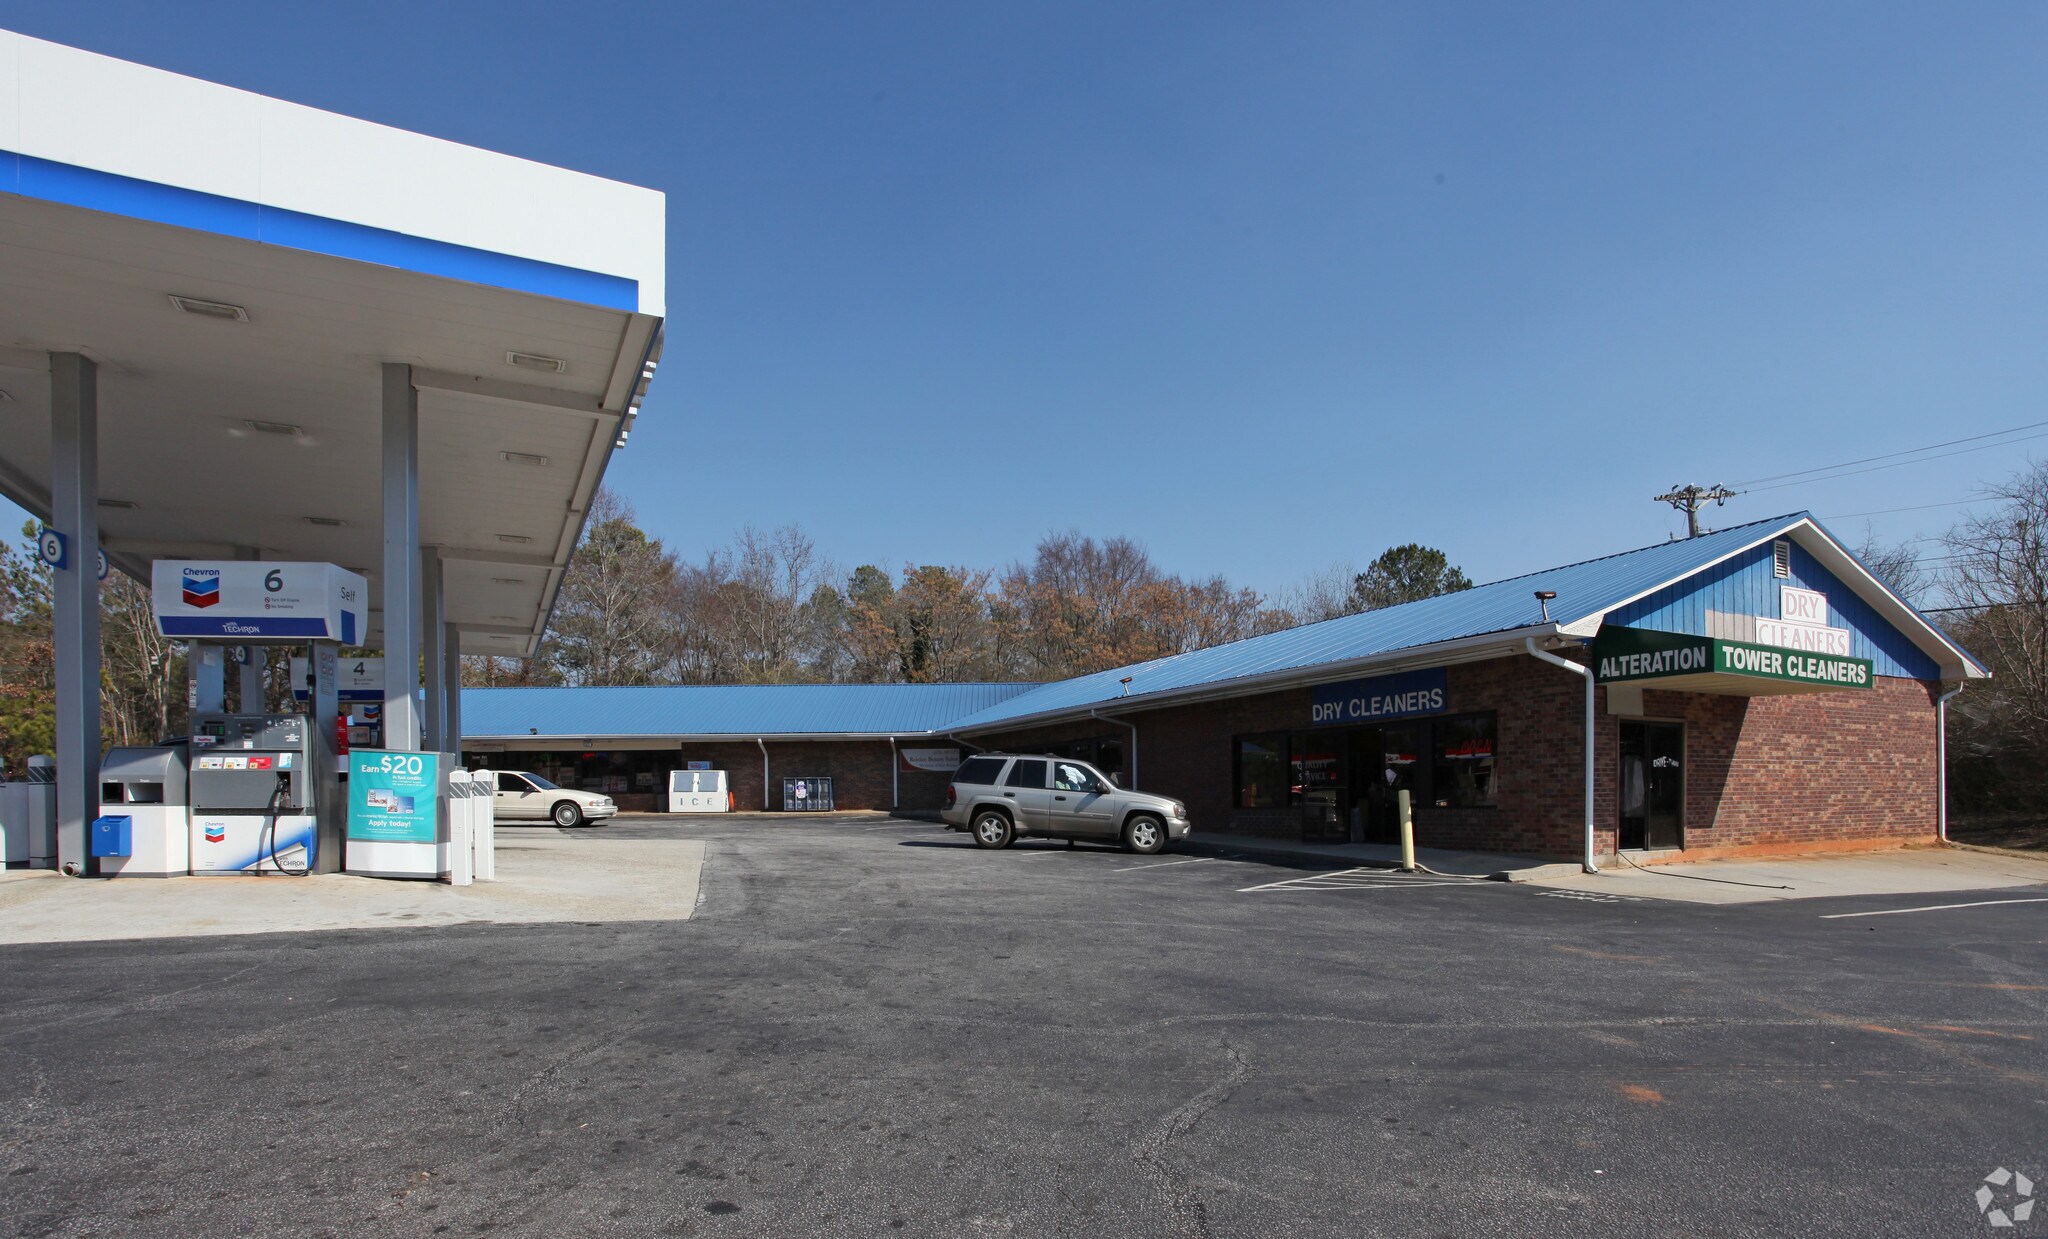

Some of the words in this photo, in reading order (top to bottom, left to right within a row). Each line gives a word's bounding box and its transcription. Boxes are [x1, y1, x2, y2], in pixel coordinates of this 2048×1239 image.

[47, 540, 57, 556] 6
[183, 567, 220, 576] Chevron
[264, 568, 283, 592] 6
[341, 586, 356, 603] Self
[1784, 592, 1819, 619] DRY
[222, 624, 260, 635] TECHRON
[1758, 623, 1848, 656] CLEANERS
[353, 661, 365, 676] 4
[1599, 646, 1706, 679] ALTERATION
[1722, 645, 1783, 675] TOWER
[1786, 655, 1867, 684] CLEANERS
[1312, 701, 1343, 722] DRY
[1349, 688, 1443, 718] CLEANERS
[361, 764, 380, 773] Earn
[380, 754, 423, 775] $20
[368, 819, 387, 828] Apply
[389, 820, 411, 828] today!
